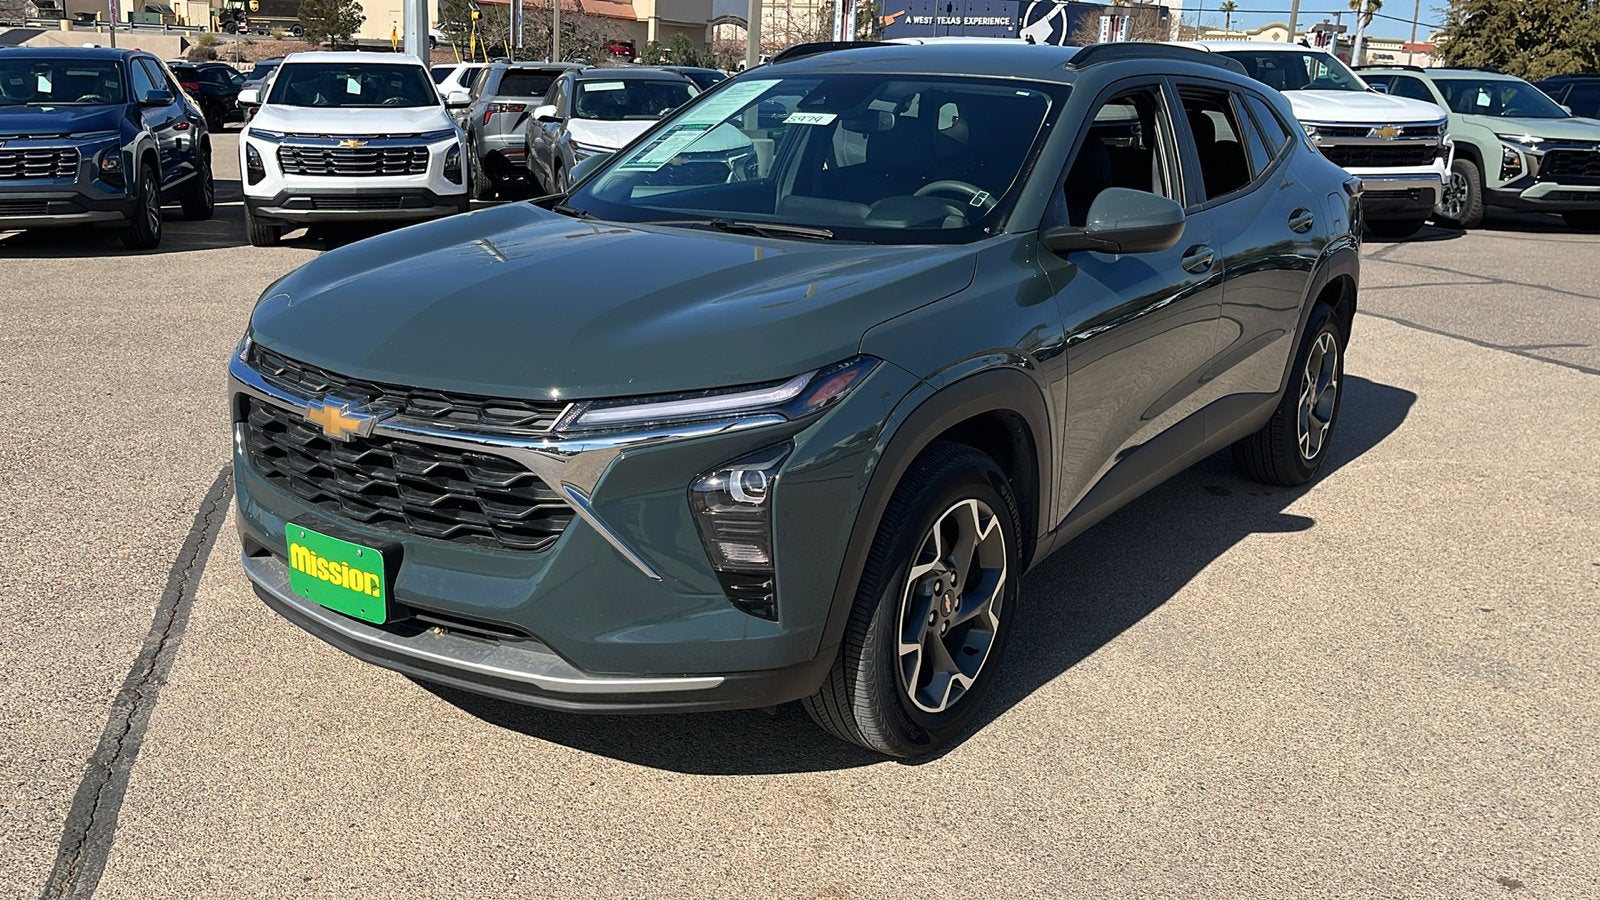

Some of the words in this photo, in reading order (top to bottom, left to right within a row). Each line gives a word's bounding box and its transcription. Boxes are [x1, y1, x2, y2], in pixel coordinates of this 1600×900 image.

[905, 16, 912, 24] A
[913, 16, 933, 24] WEST
[937, 16, 961, 25] TEXAS
